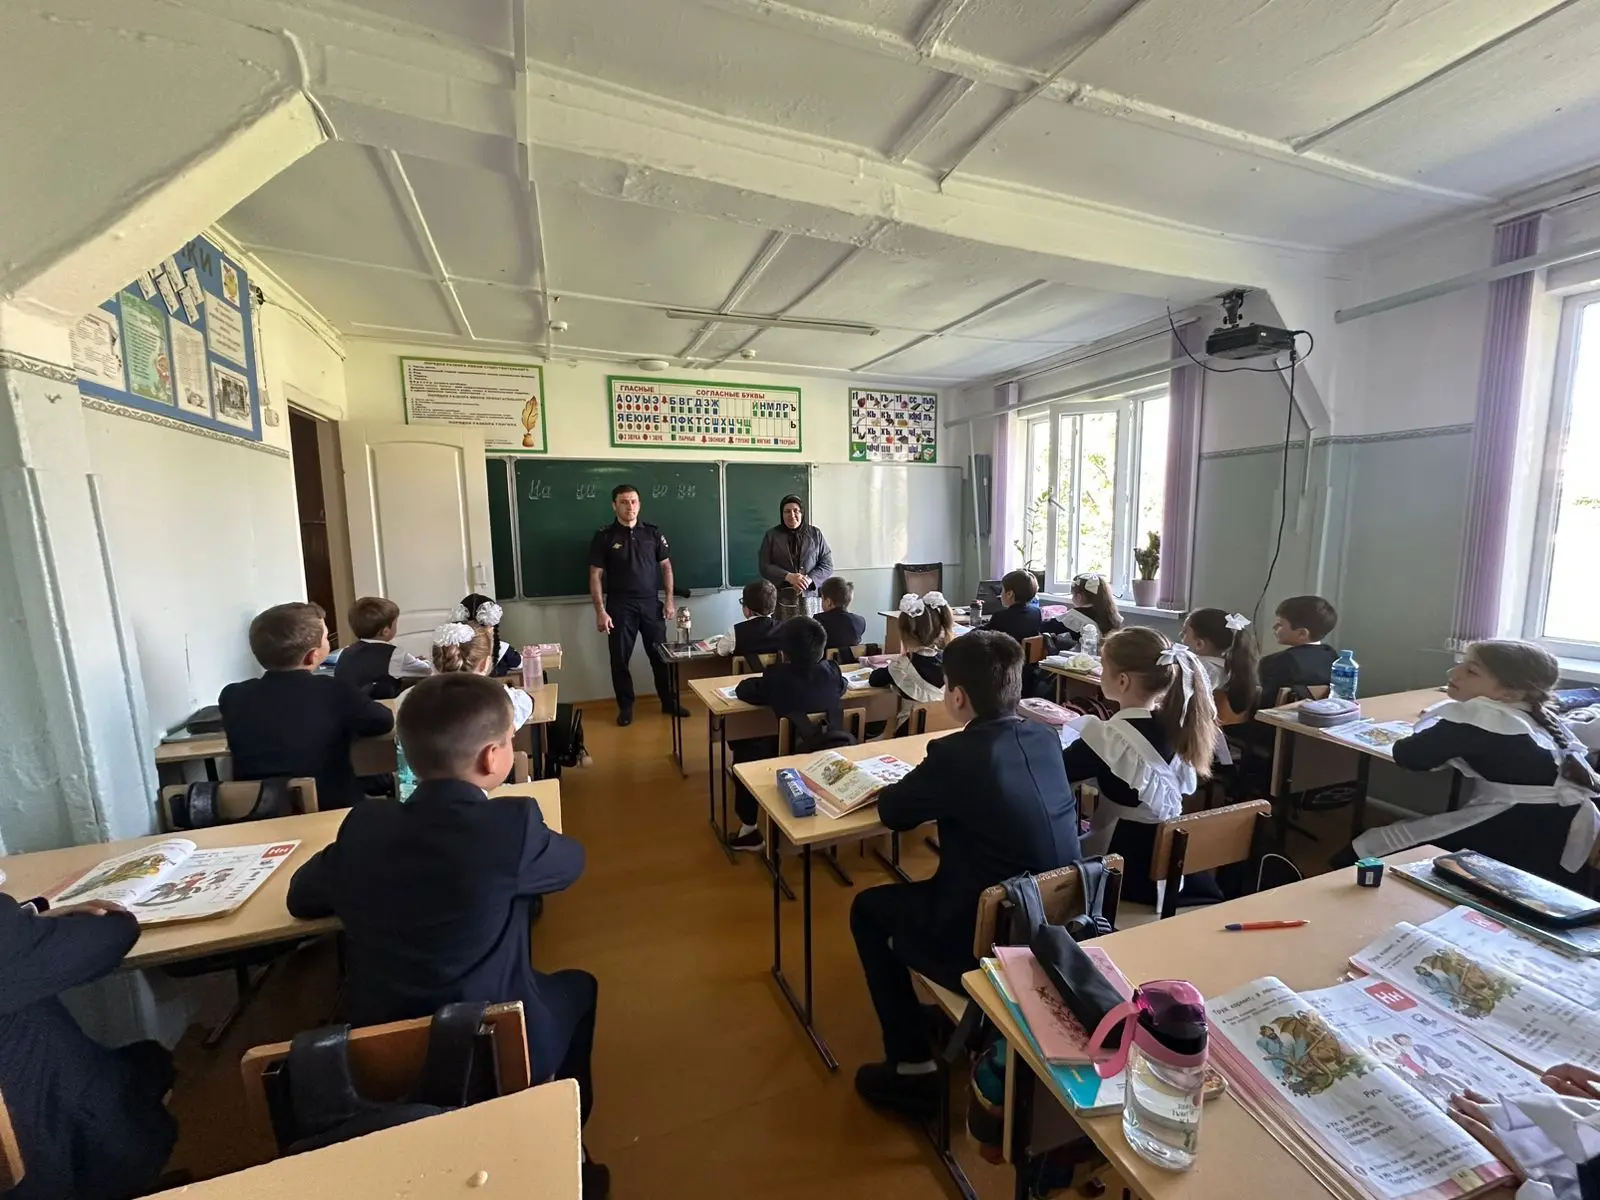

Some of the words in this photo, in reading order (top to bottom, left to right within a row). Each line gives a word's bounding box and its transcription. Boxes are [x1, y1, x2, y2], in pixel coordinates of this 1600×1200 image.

[181, 241, 213, 277] КИ
[696, 389, 740, 398] СОГЛАСНЫЕ
[1374, 992, 1404, 1004] Нн
